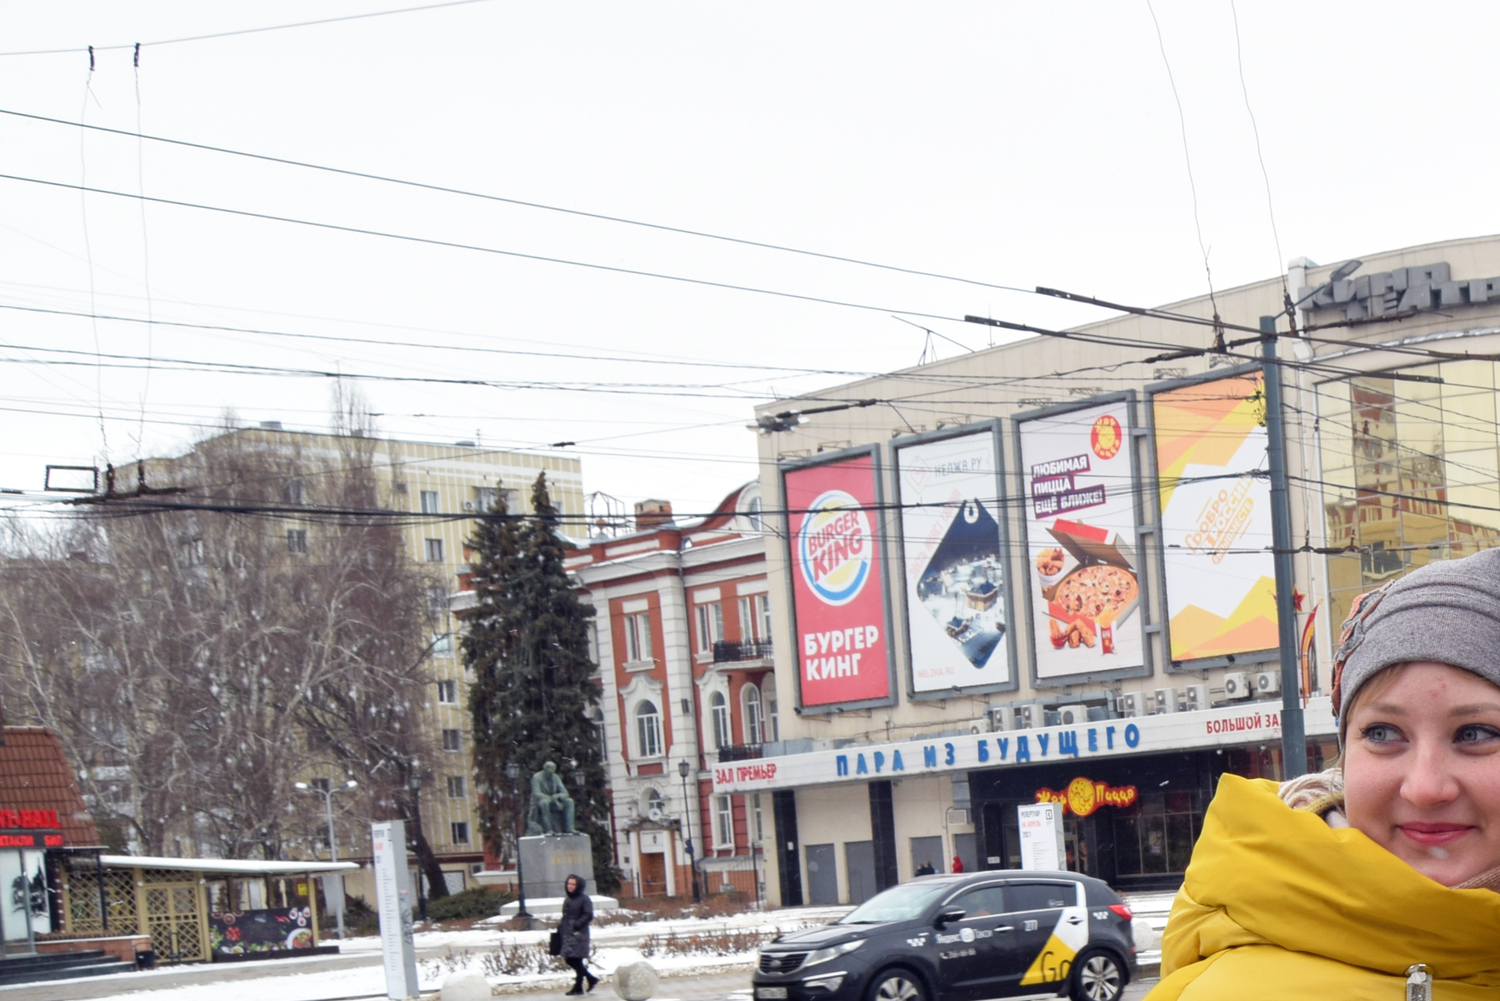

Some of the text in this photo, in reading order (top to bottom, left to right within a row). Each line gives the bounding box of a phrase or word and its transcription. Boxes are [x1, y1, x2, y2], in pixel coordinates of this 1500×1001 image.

[1033, 455, 1087, 478] ЛЮБИМАЯ
[1034, 477, 1071, 496] ПИЦЦА
[1035, 490, 1103, 514] ЕЩЁ БЛИЖЕ!
[809, 510, 859, 557] BURGER
[812, 527, 863, 583] KING
[804, 625, 879, 656] БУРГЕР
[806, 653, 861, 681] КИНГ
[1206, 712, 1281, 734] БОЛЬШОЙ ЗА
[836, 723, 1139, 777] ПАРА ИЗ БУДУЩЕГО
[716, 763, 777, 785] ЗАЛ ПРЕМЬЕР
[1040, 951, 1072, 983] Go
